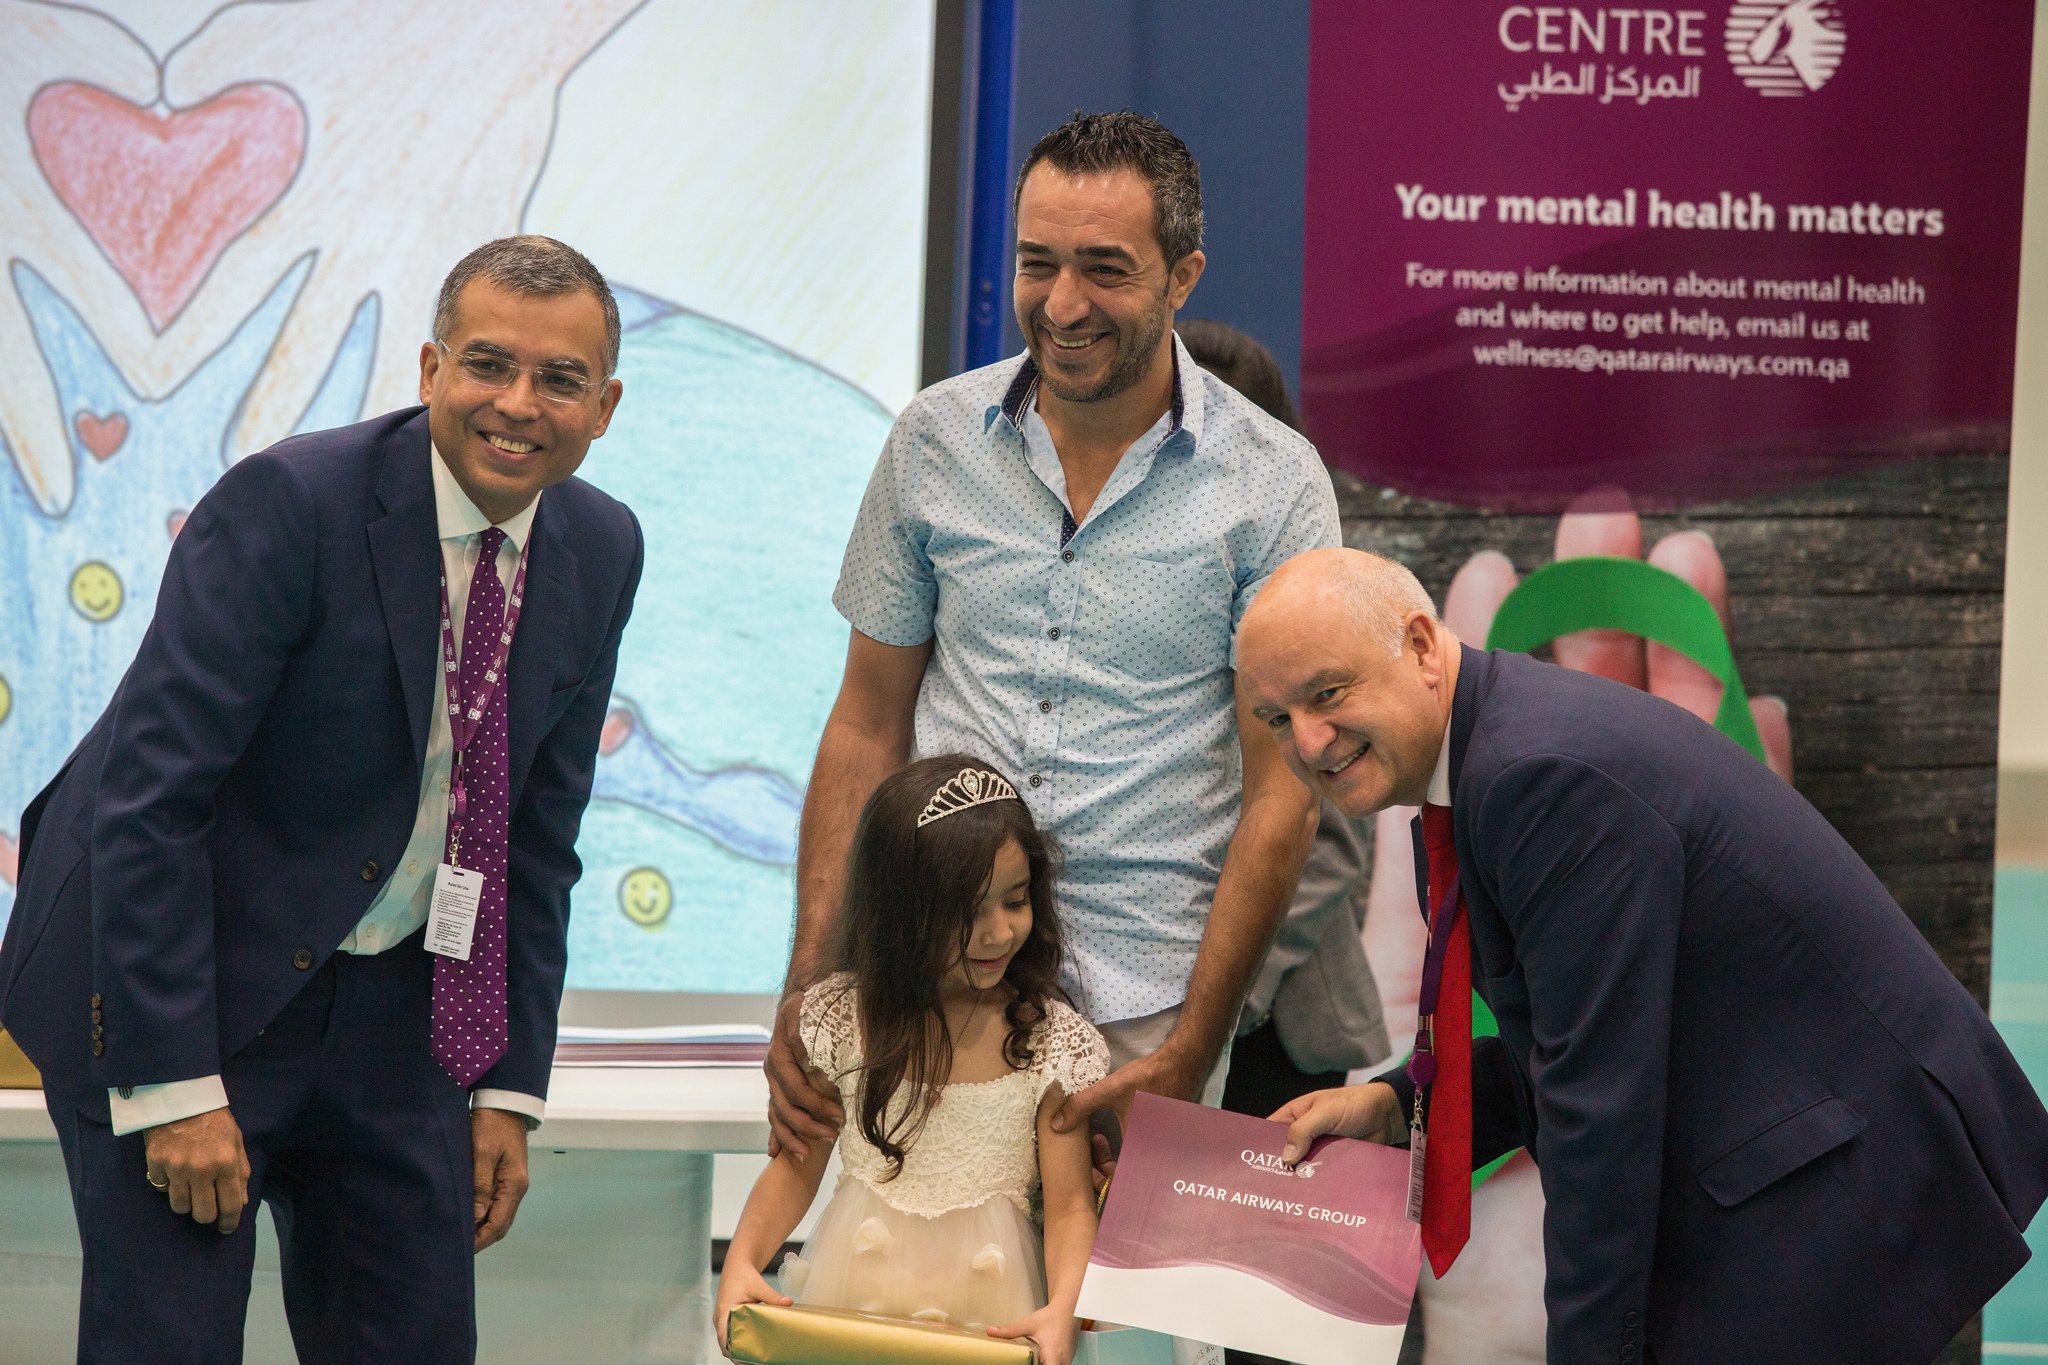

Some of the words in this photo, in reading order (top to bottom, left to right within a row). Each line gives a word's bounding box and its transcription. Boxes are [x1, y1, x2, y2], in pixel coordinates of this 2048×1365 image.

[1498, 6, 1706, 56] CENTRE
[1497, 61, 1597, 112] الطبي
[1598, 63, 1701, 106] المركز
[1395, 183, 1487, 222] Your
[1496, 187, 1637, 227] mental
[1648, 188, 1776, 231] health
[1787, 200, 1944, 237] matters
[1406, 262, 1448, 289] For
[1453, 269, 1519, 292] more
[1523, 265, 1668, 296] information
[1673, 270, 1747, 299] about
[1754, 274, 1841, 302] mental
[1848, 275, 1925, 305] health
[1455, 301, 1505, 329] and
[1510, 302, 1587, 332] where
[1592, 308, 1618, 333] to
[1622, 311, 1664, 339] get
[1670, 307, 1730, 341] help,
[1736, 311, 1805, 339] email
[1812, 319, 1840, 341] us
[1845, 318, 1870, 341] at
[1472, 339, 1850, 383] wellness@qatarairways.com.qa
[1173, 1179, 1227, 1201] QATAR
[1230, 1191, 1304, 1216] AIRWAYS
[1308, 1206, 1367, 1228] GROUP
